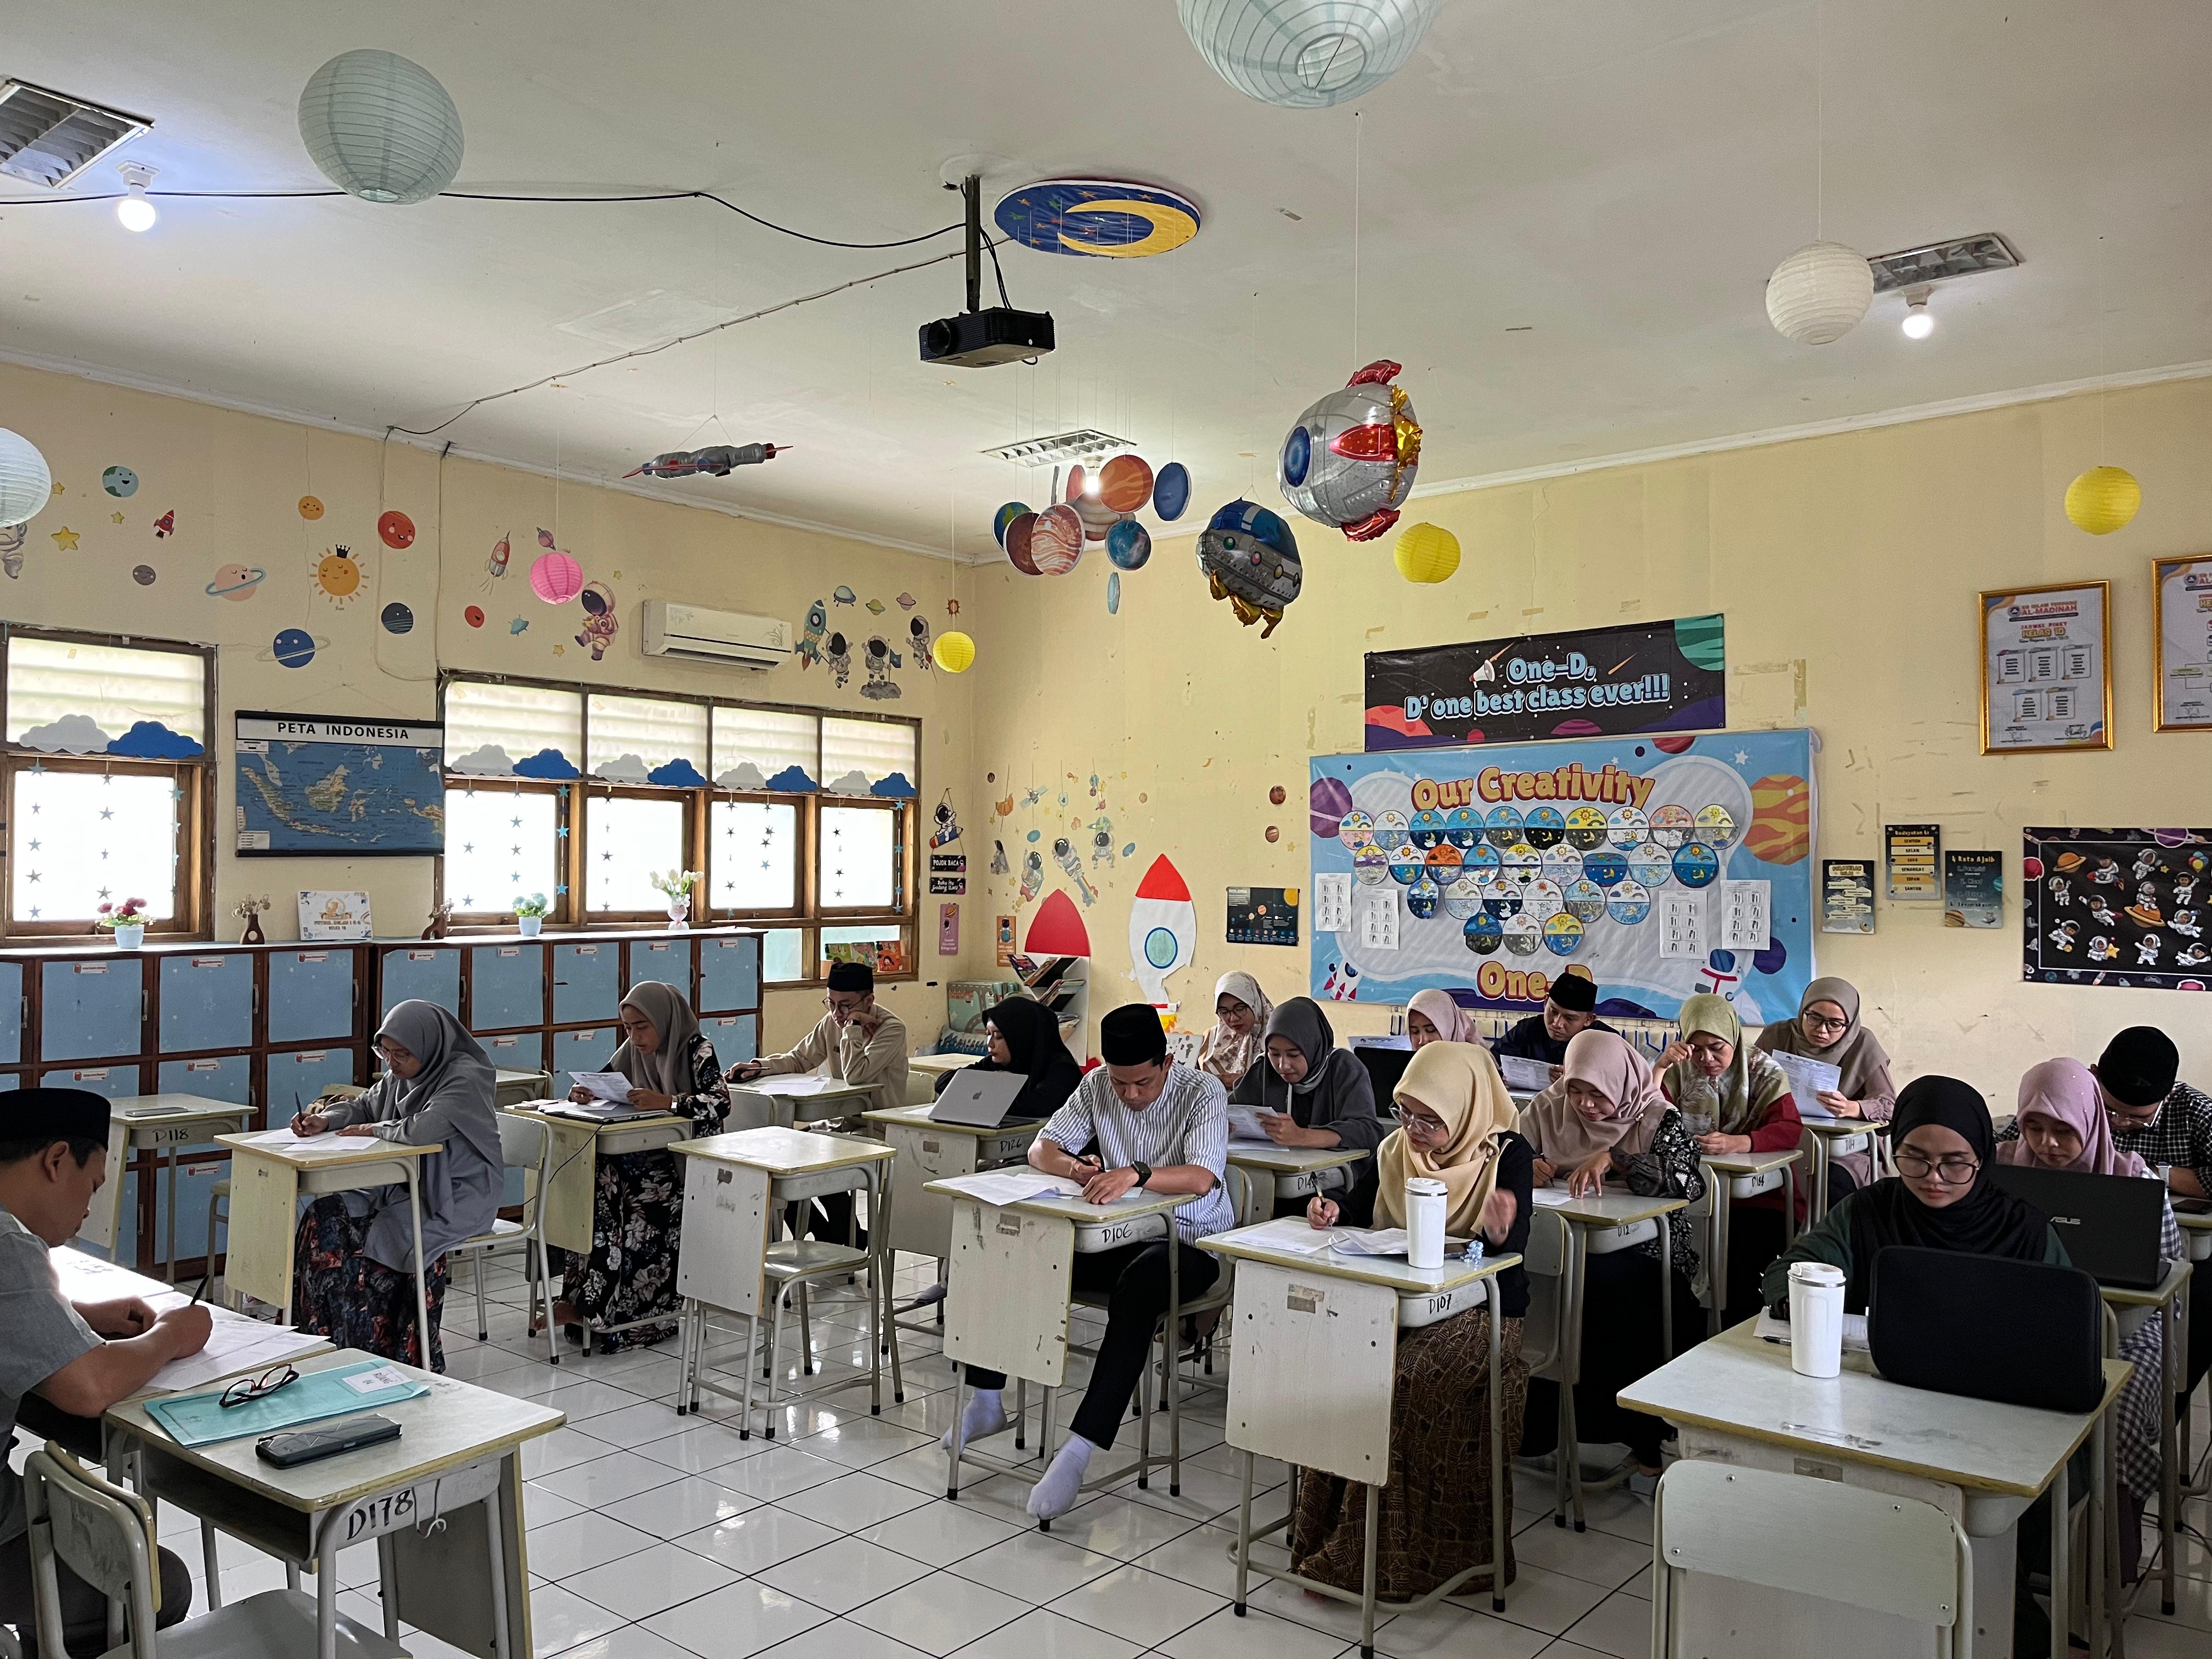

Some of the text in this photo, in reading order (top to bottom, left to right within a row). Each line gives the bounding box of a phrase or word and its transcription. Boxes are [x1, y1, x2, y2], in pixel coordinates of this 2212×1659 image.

[2022, 605, 2078, 616] AL-MADINAH
[2022, 628, 2052, 639] KELAS
[1507, 652, 1597, 684] One-D,
[1430, 695, 1473, 720] one
[1475, 689, 1526, 716] best
[1526, 684, 1587, 712] class
[1589, 674, 1671, 704] ever!!!
[278, 722, 409, 739] PETA INDONESIA
[1412, 763, 1656, 812] Our Creativity
[151, 1128, 189, 1142] D118
[1297, 1177, 1315, 1190] D14
[2050, 1216, 2081, 1225] ASUS
[1102, 1223, 1133, 1243] D106
[1427, 1294, 1452, 1314] D107
[347, 1489, 414, 1541] D178
